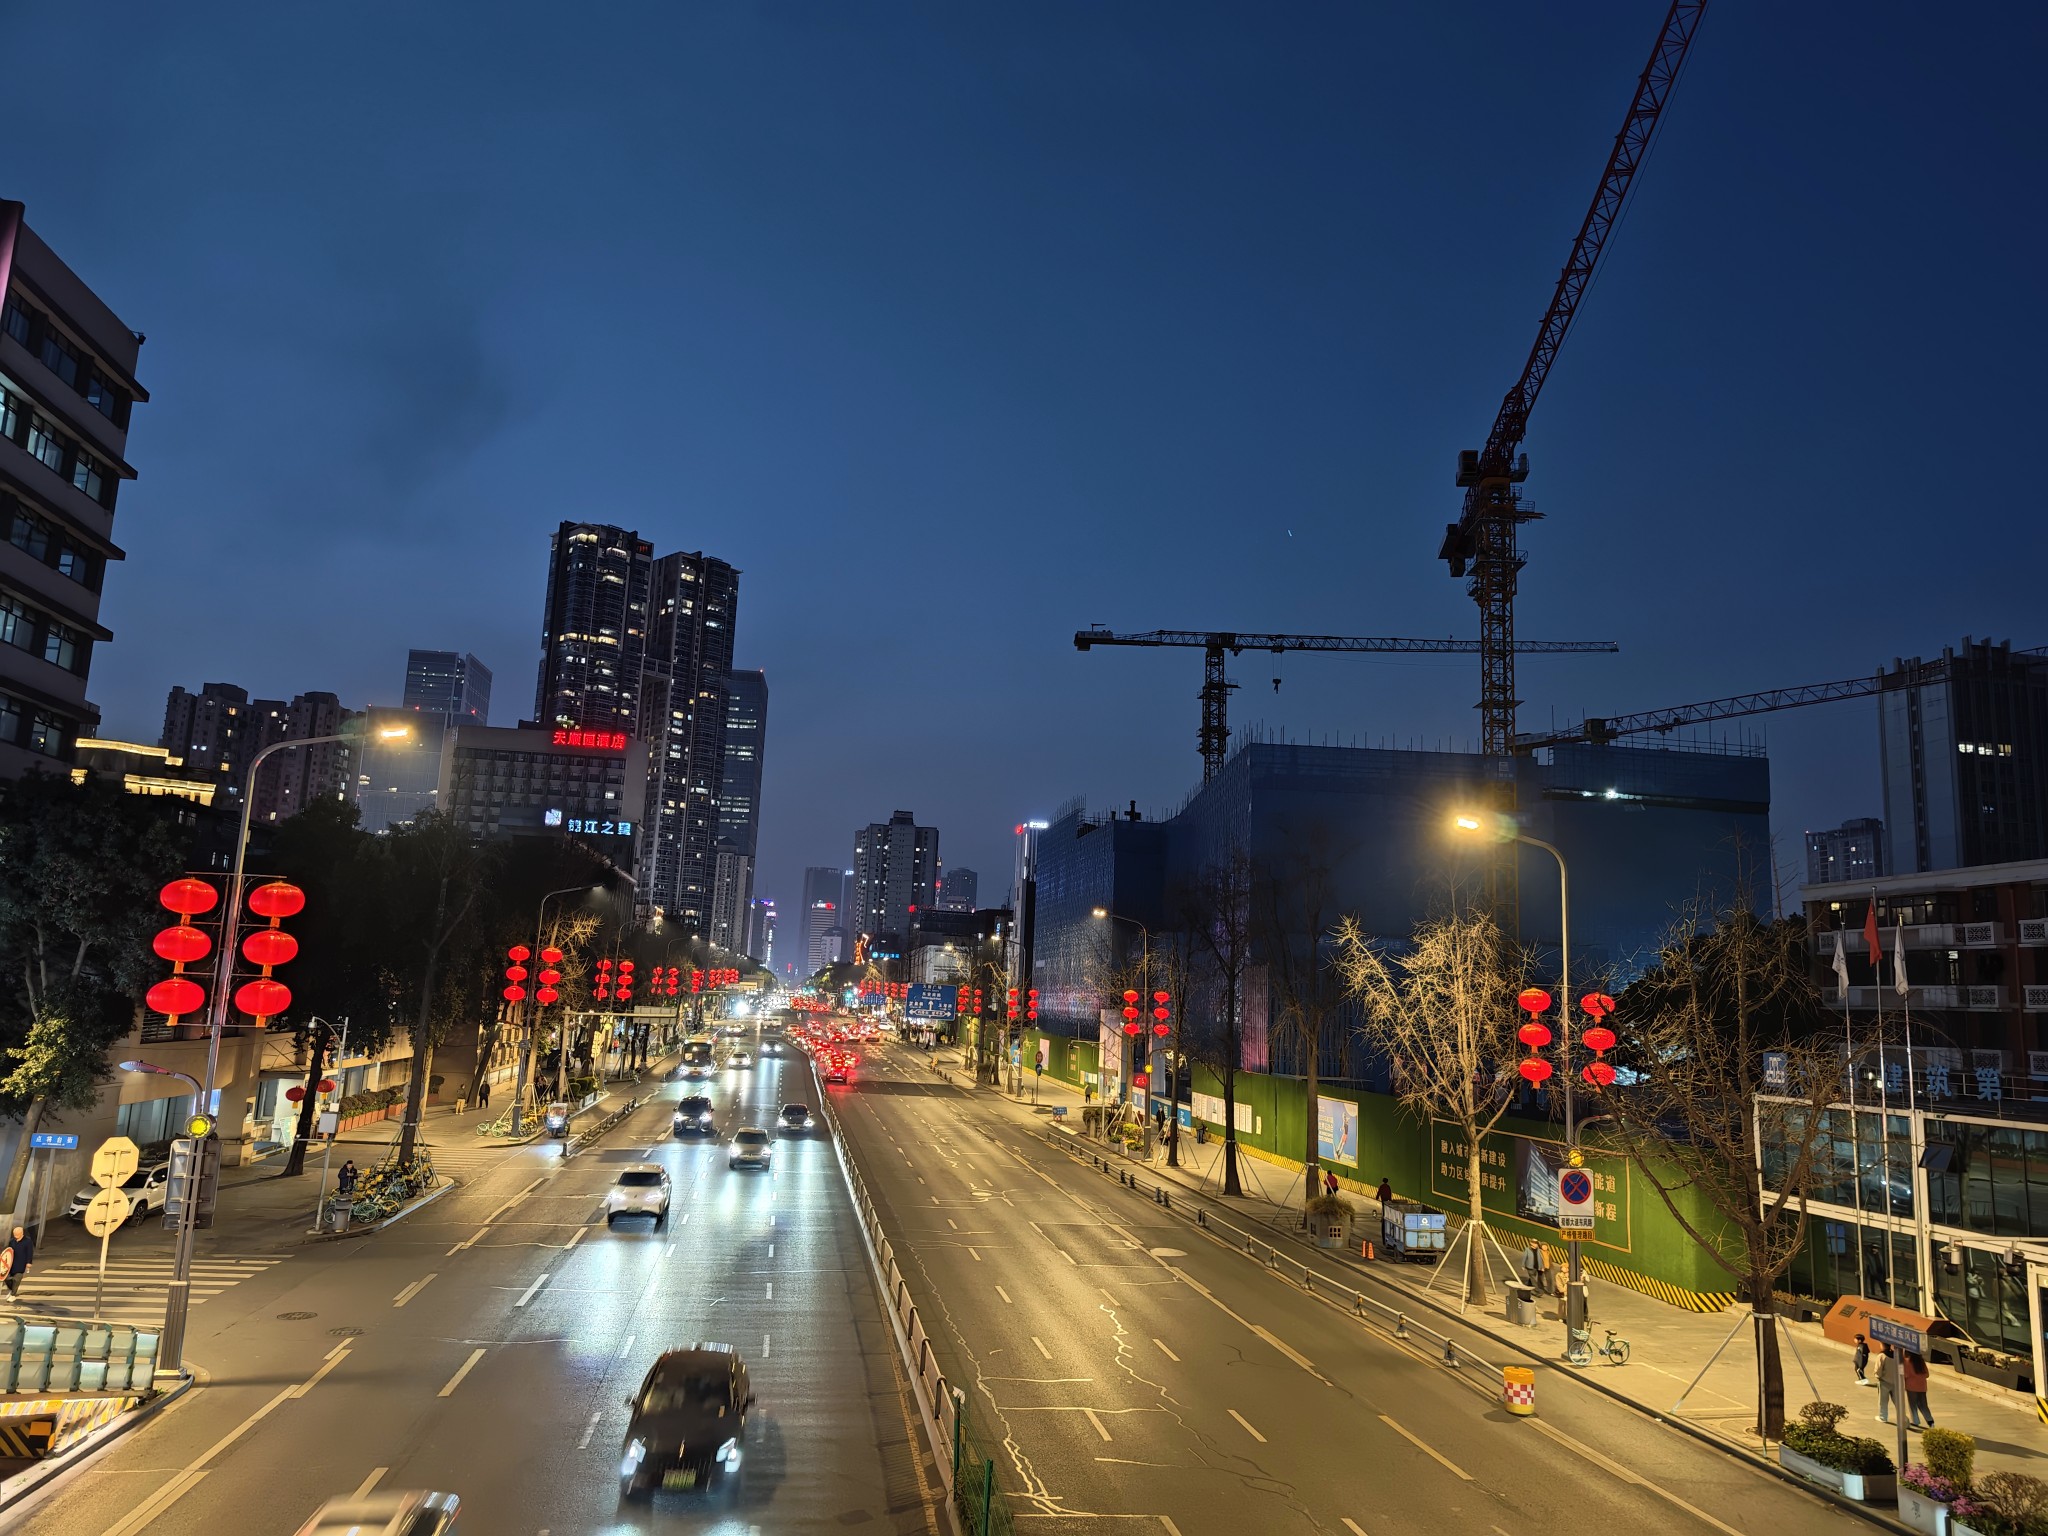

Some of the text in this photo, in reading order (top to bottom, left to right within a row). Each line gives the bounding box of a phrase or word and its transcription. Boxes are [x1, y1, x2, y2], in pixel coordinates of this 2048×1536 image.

[568, 819, 631, 836] 锦江之星
[1441, 1140, 1506, 1168] 融入城市新建设
[1441, 1162, 1506, 1192] 助力区域质提升
[1561, 1231, 1593, 1239] 严格管理路段
[1871, 1319, 1918, 1344] 蜀都大道东风路
